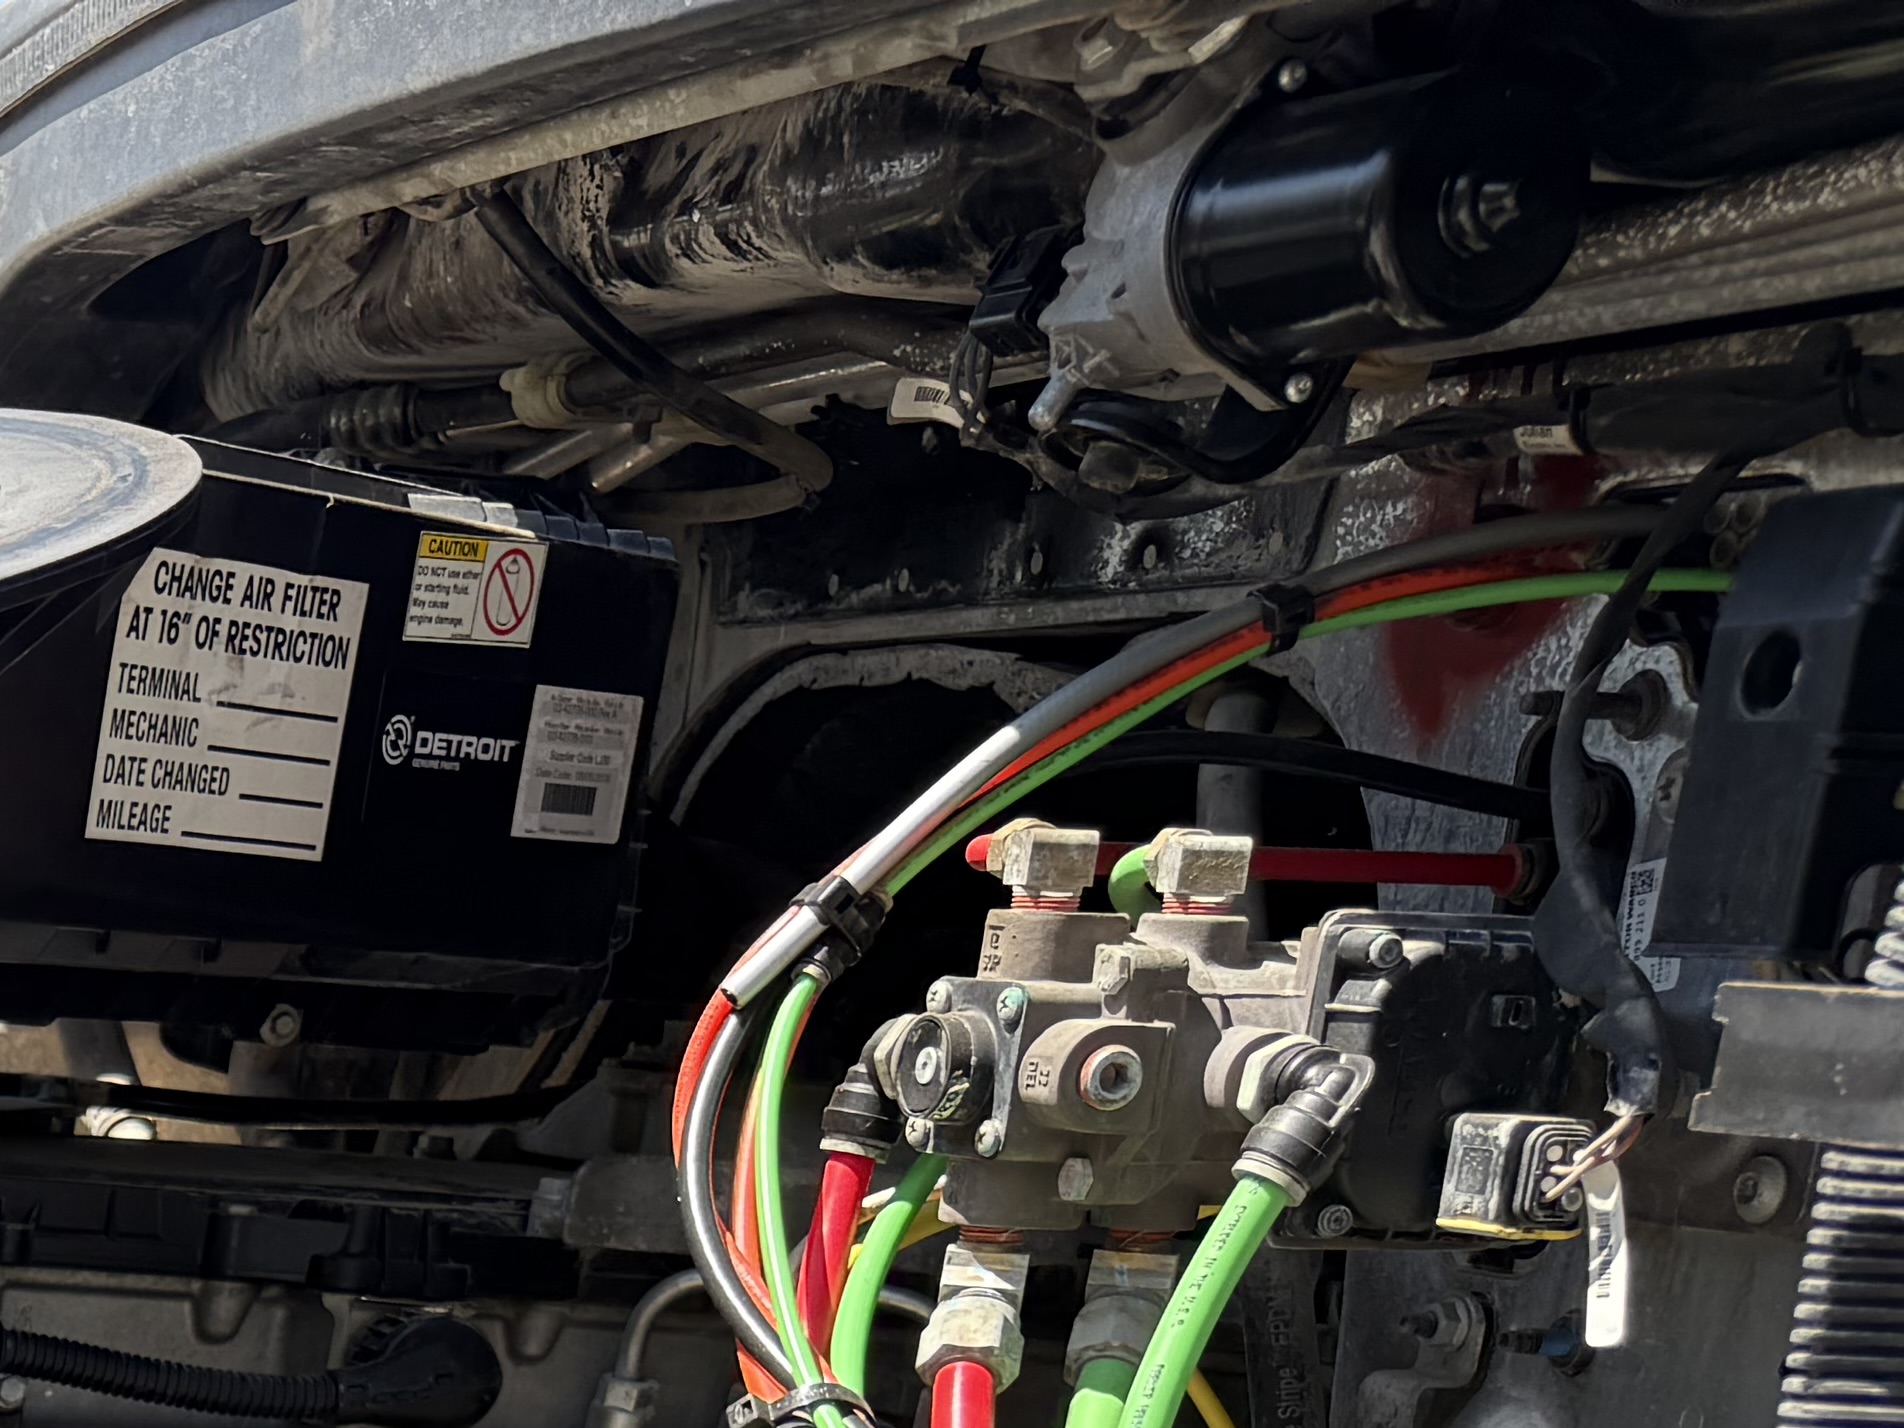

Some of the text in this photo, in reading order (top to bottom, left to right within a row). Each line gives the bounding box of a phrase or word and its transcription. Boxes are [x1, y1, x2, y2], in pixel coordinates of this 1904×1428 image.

[429, 539, 479, 557] CAUTION
[154, 561, 341, 622] CHANGE AIR FILTER
[126, 605, 153, 641] AT
[195, 615, 222, 650] OF
[225, 619, 350, 669] RESTRICTION
[118, 663, 201, 702] TERMINAL
[109, 708, 199, 748] MECHANIC
[415, 731, 520, 762] DETROIT
[103, 754, 229, 796] DATE CHANGED
[96, 799, 172, 834] MILEAGE
[1272, 1365, 1303, 1419] Stripe
